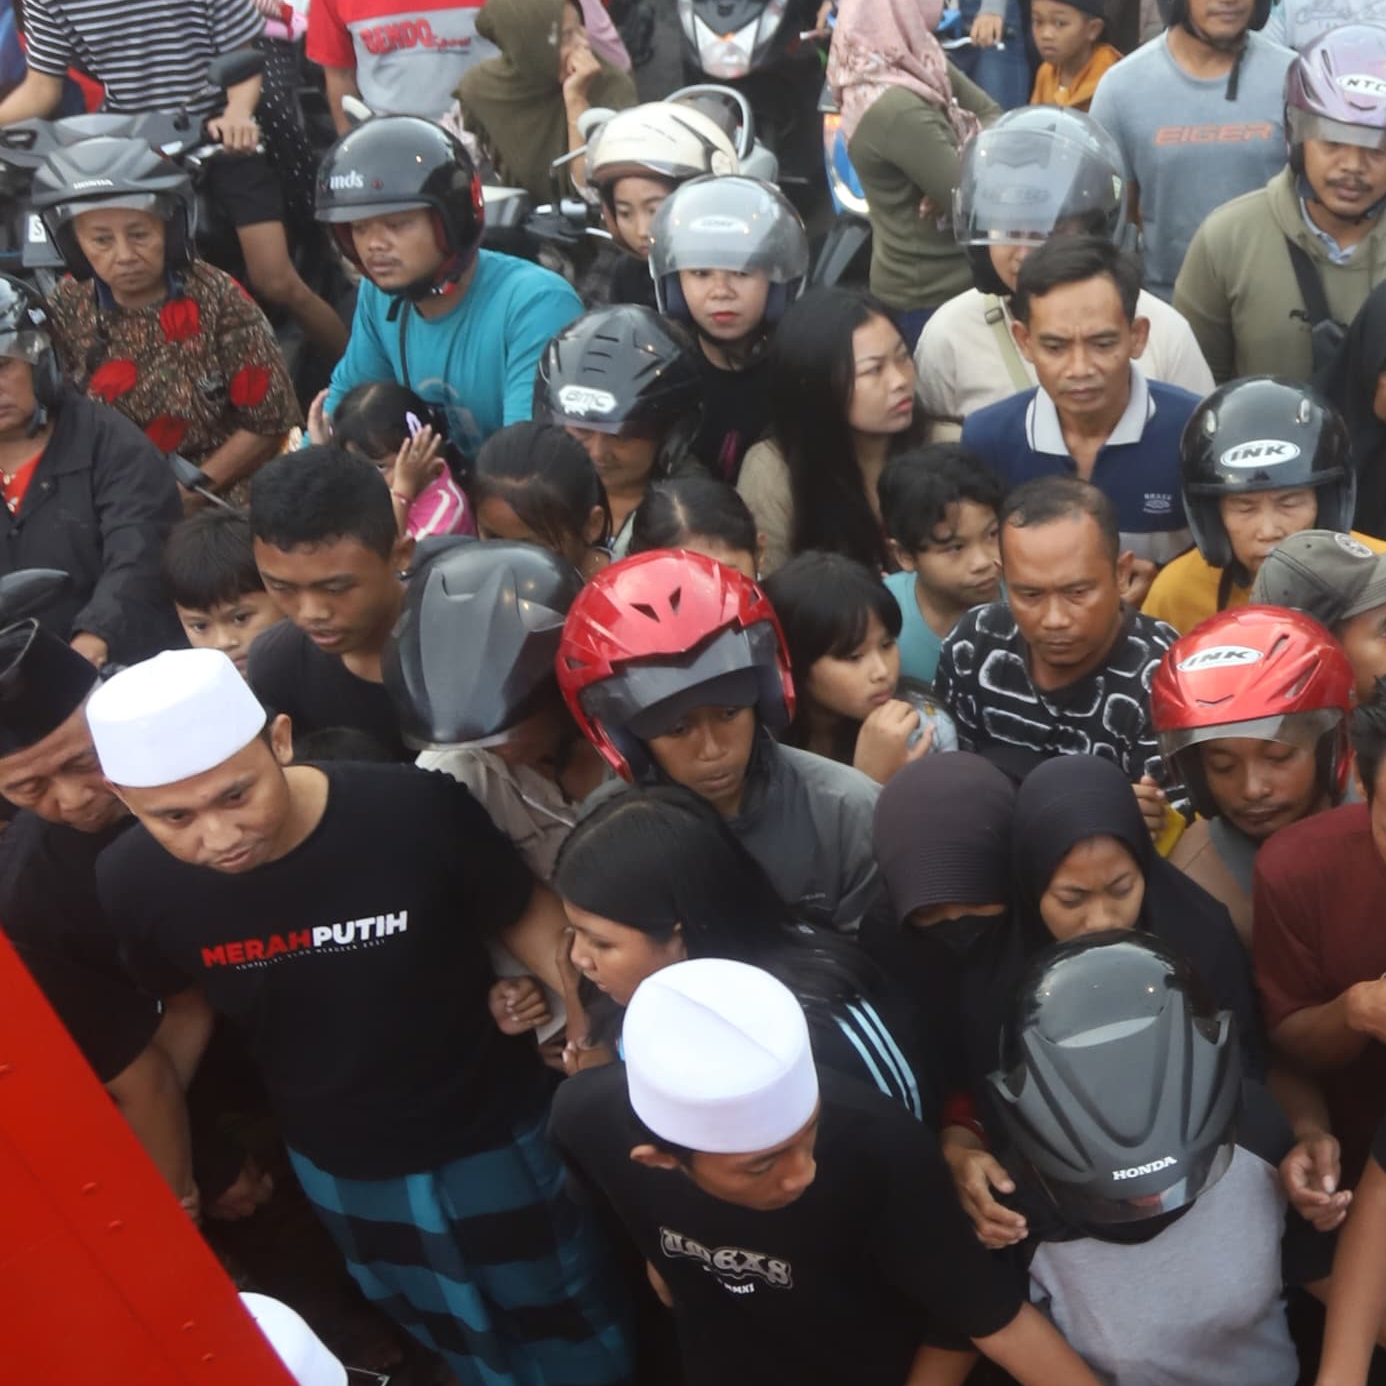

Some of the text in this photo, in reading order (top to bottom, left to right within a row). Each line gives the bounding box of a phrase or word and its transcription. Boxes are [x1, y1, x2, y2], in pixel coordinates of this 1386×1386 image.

[1155, 122, 1273, 146] EIGER
[330, 169, 364, 190] mds
[1230, 445, 1287, 462] INK
[1188, 651, 1248, 667] INK
[1112, 1156, 1178, 1181] HONDA
